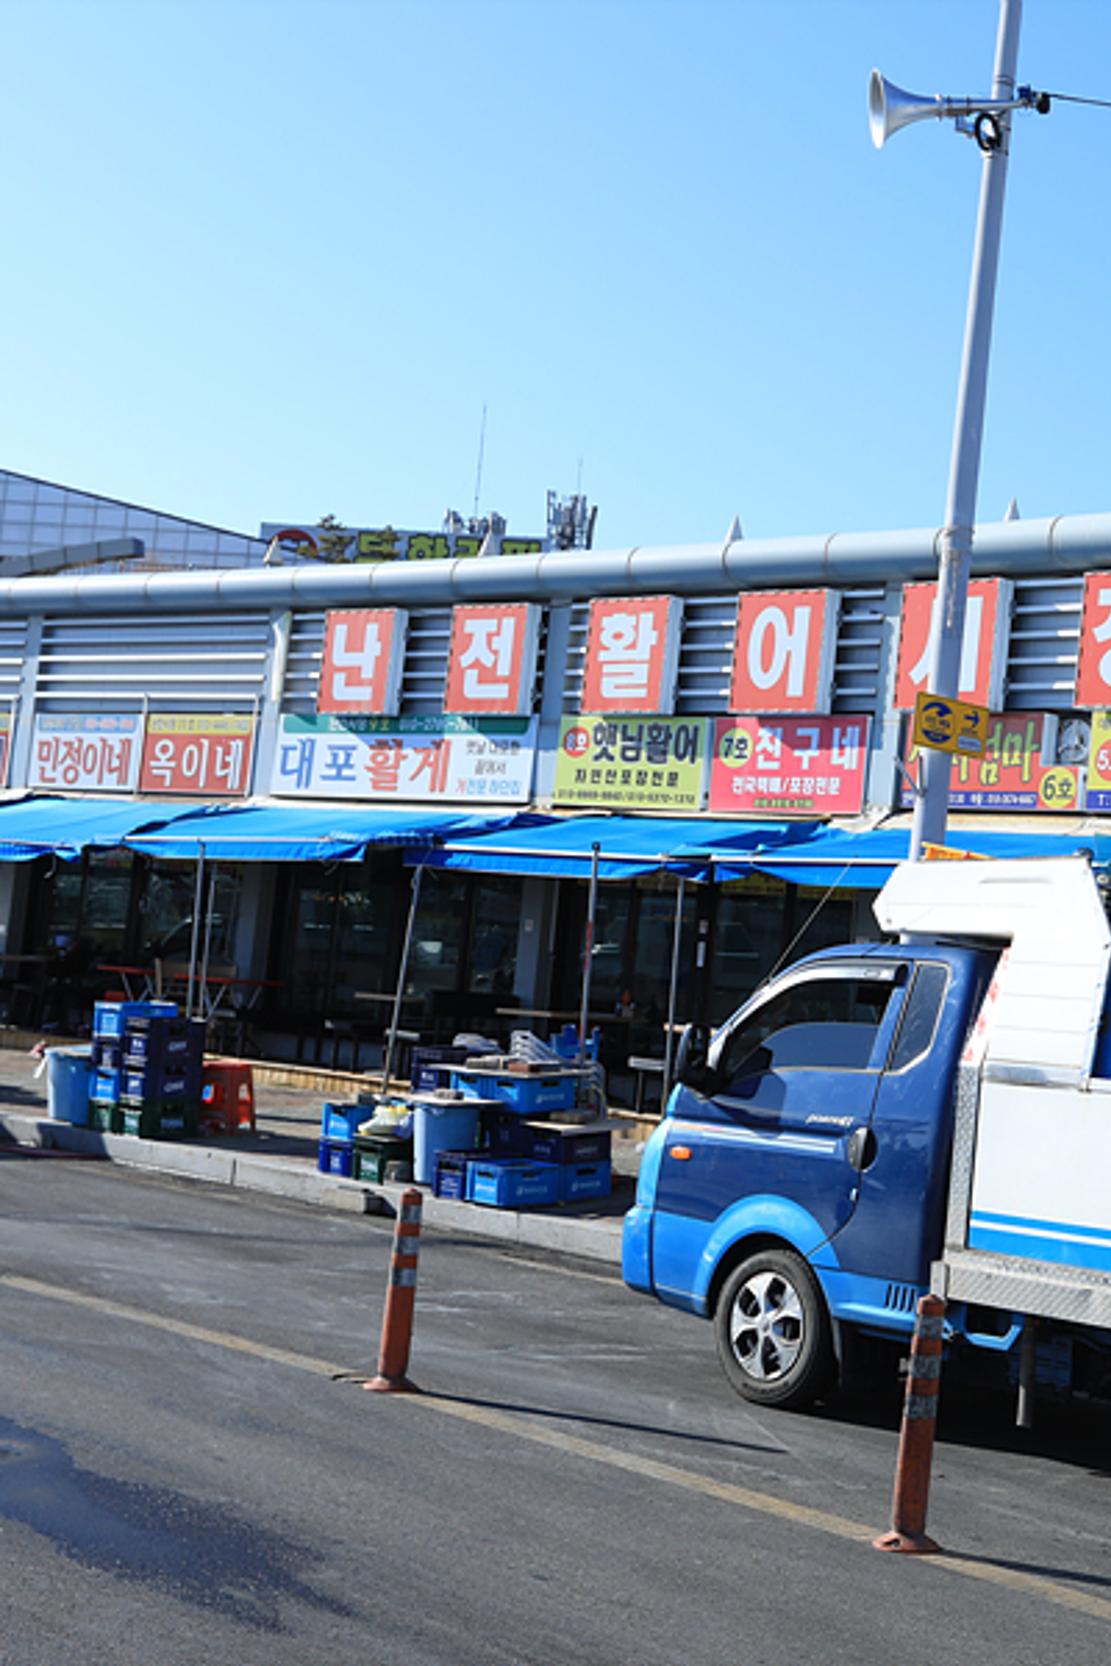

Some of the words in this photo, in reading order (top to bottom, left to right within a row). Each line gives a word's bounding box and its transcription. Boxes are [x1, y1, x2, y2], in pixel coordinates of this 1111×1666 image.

[37, 736, 133, 785] 민정이네
[150, 738, 244, 789] 옥이네
[724, 737, 748, 759] 7호
[1044, 775, 1073, 800] 6호
